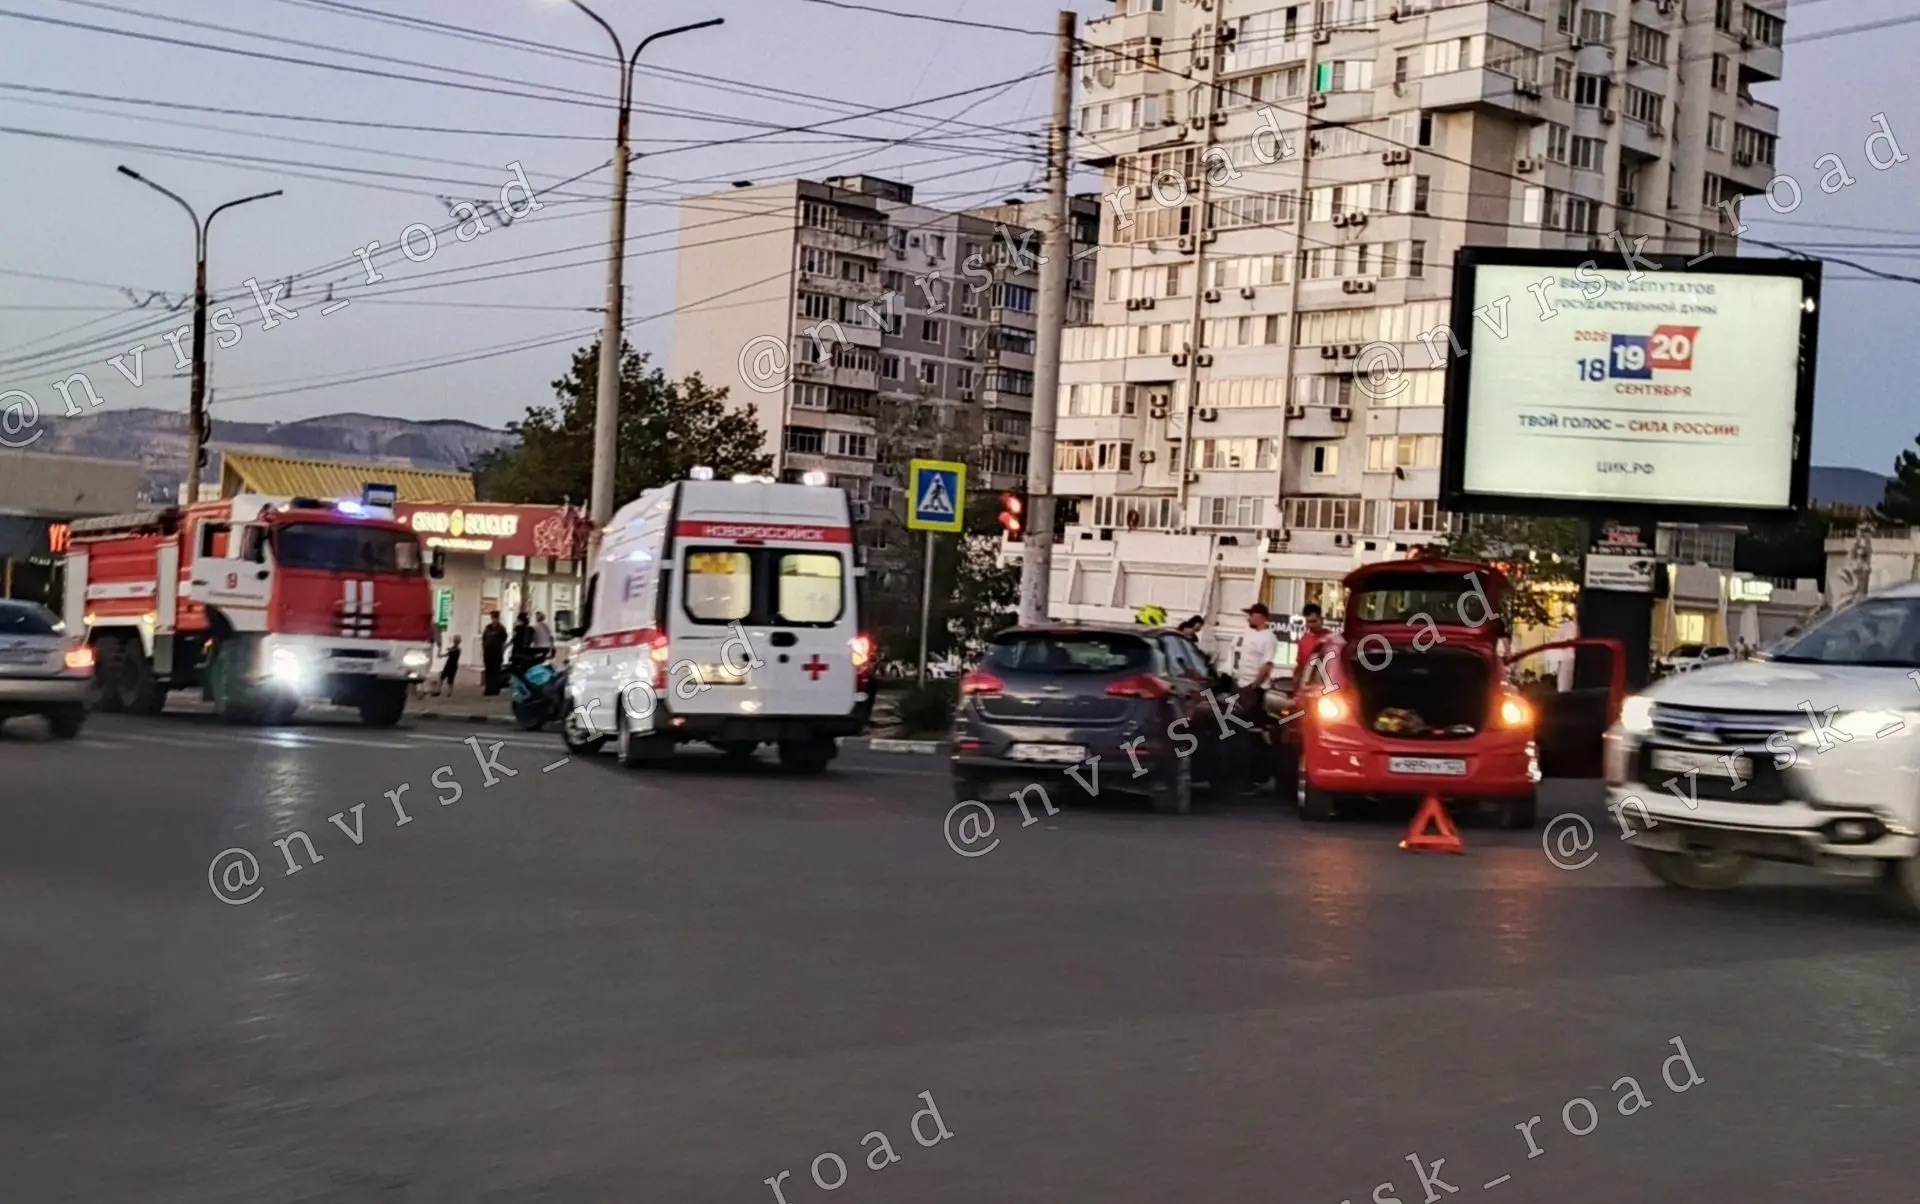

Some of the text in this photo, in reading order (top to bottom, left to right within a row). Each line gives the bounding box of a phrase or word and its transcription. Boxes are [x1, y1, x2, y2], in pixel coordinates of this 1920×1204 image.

[1628, 279, 1716, 296] ДЕПУТАТОВ
[1577, 335, 1691, 382] 18 19 20
[1614, 383, 1692, 398] СЕНТЯБРЯ
[1518, 413, 1558, 428] ТВОЙ
[1562, 416, 1612, 431] ГОЛОС
[1628, 420, 1669, 433] СИЛА
